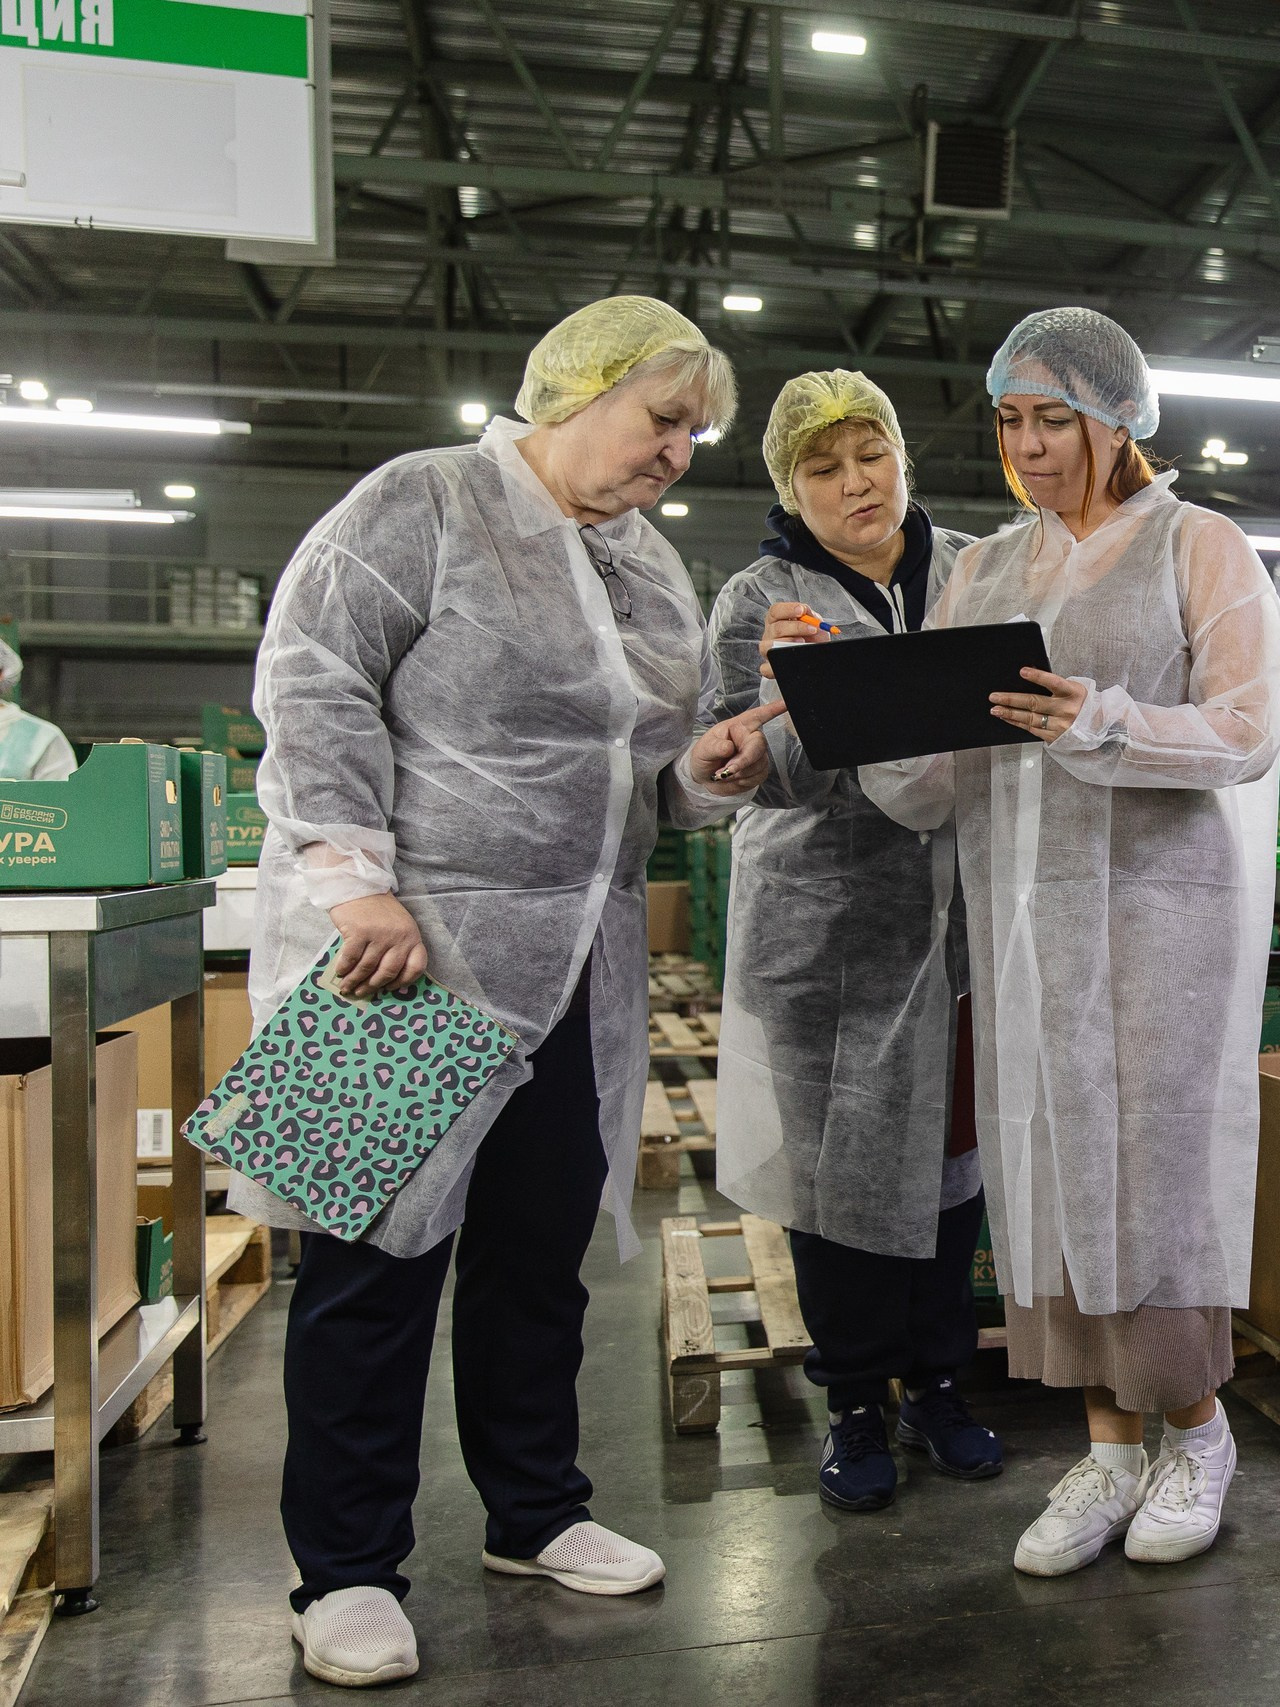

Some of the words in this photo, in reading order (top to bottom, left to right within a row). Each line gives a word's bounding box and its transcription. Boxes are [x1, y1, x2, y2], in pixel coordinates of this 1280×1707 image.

[14, 807, 55, 818] СДЕЛАНО
[227, 826, 266, 839] ТУР
[8, 856, 57, 866] уверен
